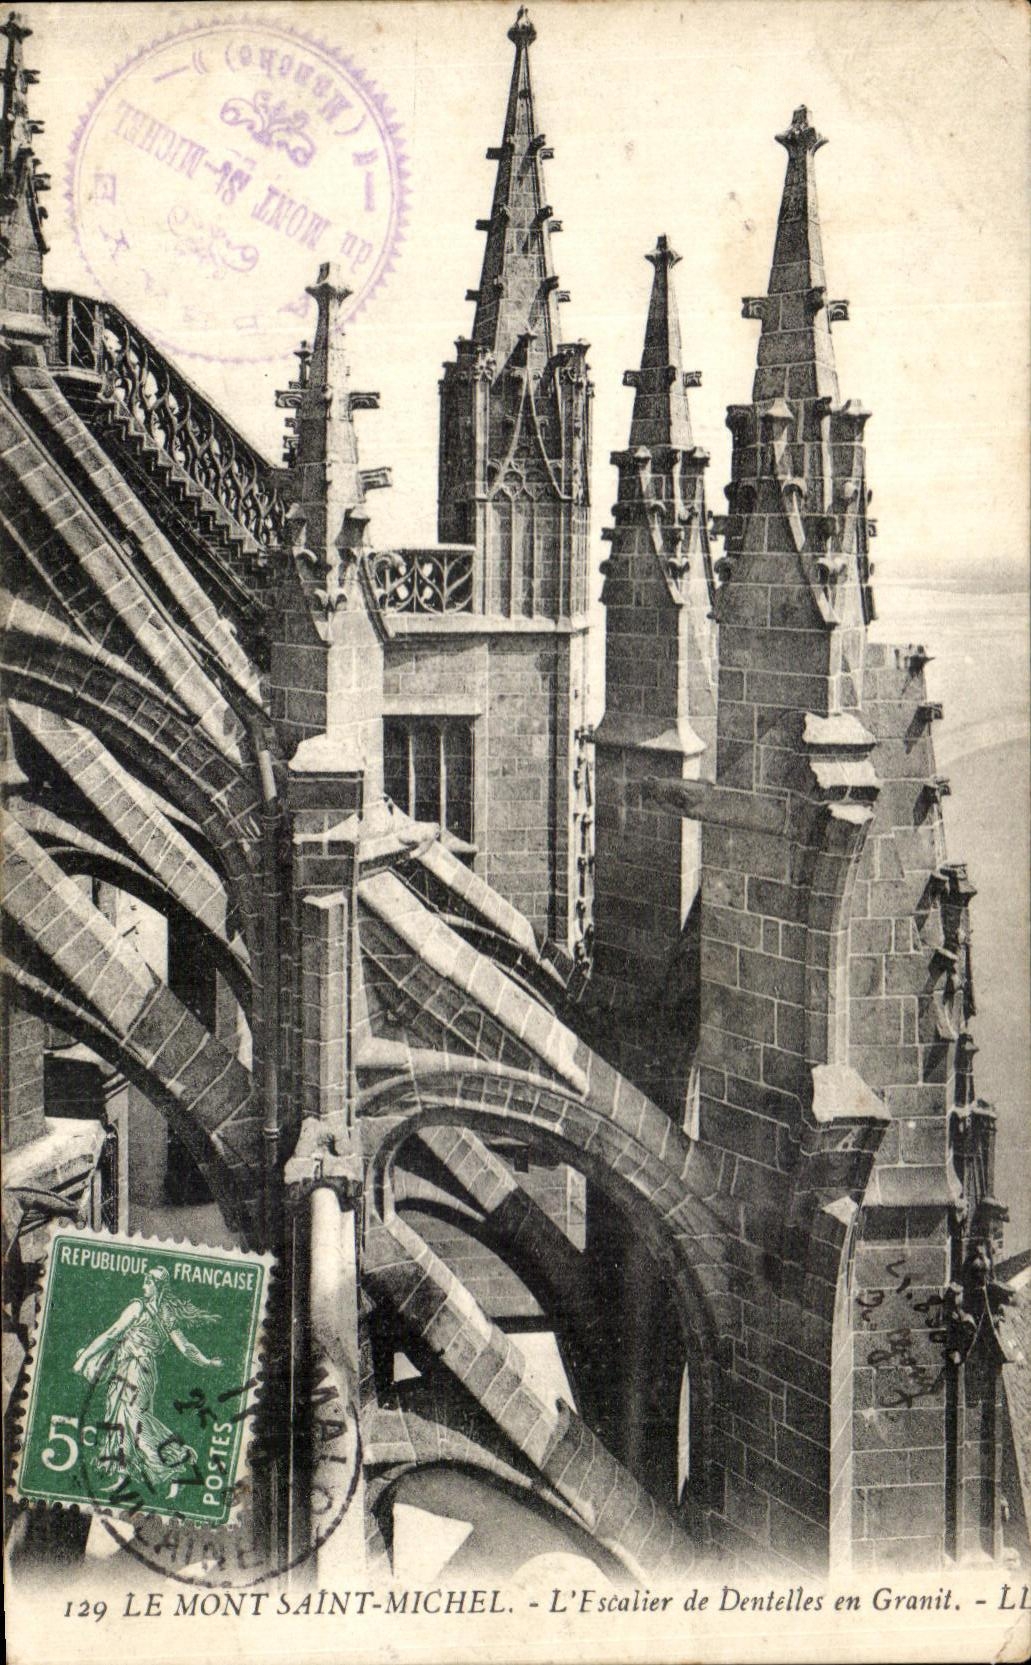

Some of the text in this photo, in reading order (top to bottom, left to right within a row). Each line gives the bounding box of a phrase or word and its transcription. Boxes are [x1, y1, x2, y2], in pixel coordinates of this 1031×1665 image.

[252, 185, 331, 250] MONT
[174, 1262, 255, 1292] FRANÇAISE
[202, 1421, 234, 1507] POSTES
